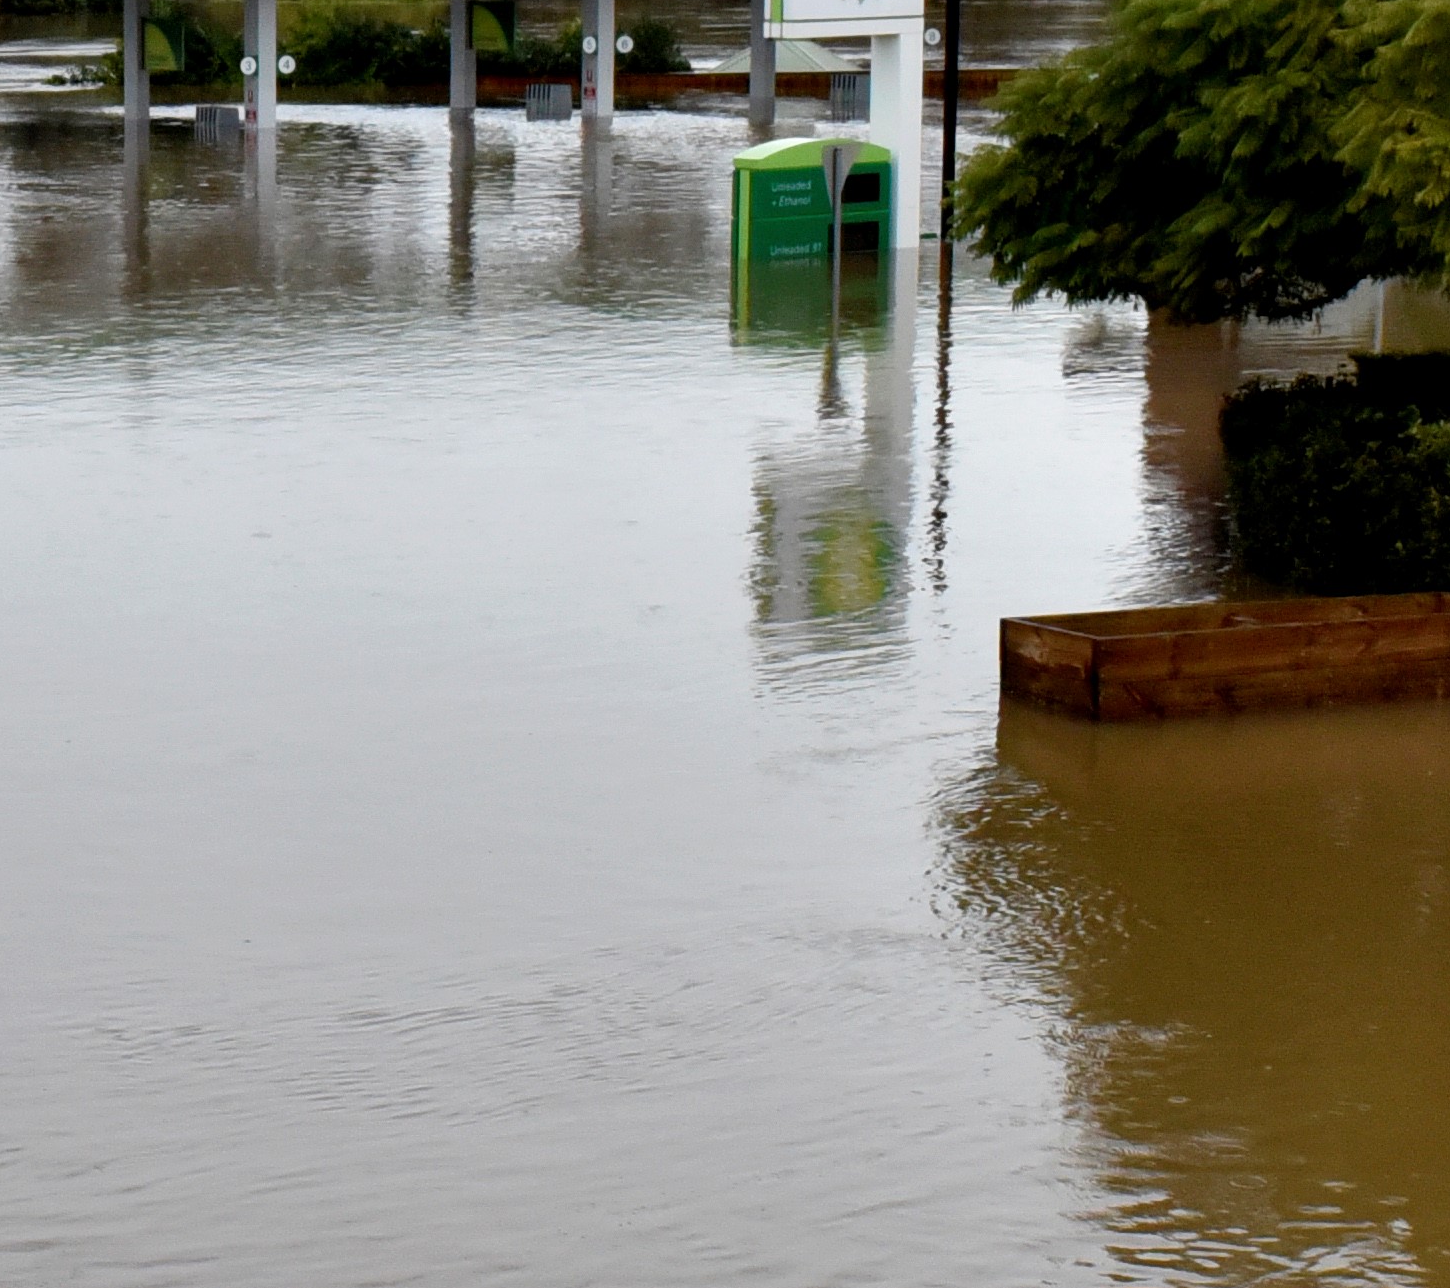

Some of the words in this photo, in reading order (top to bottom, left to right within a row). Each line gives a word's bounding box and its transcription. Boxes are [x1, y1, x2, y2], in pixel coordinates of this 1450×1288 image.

[244, 60, 252, 72] 3
[283, 59, 290, 71] 4
[779, 195, 812, 208] Ethanol
